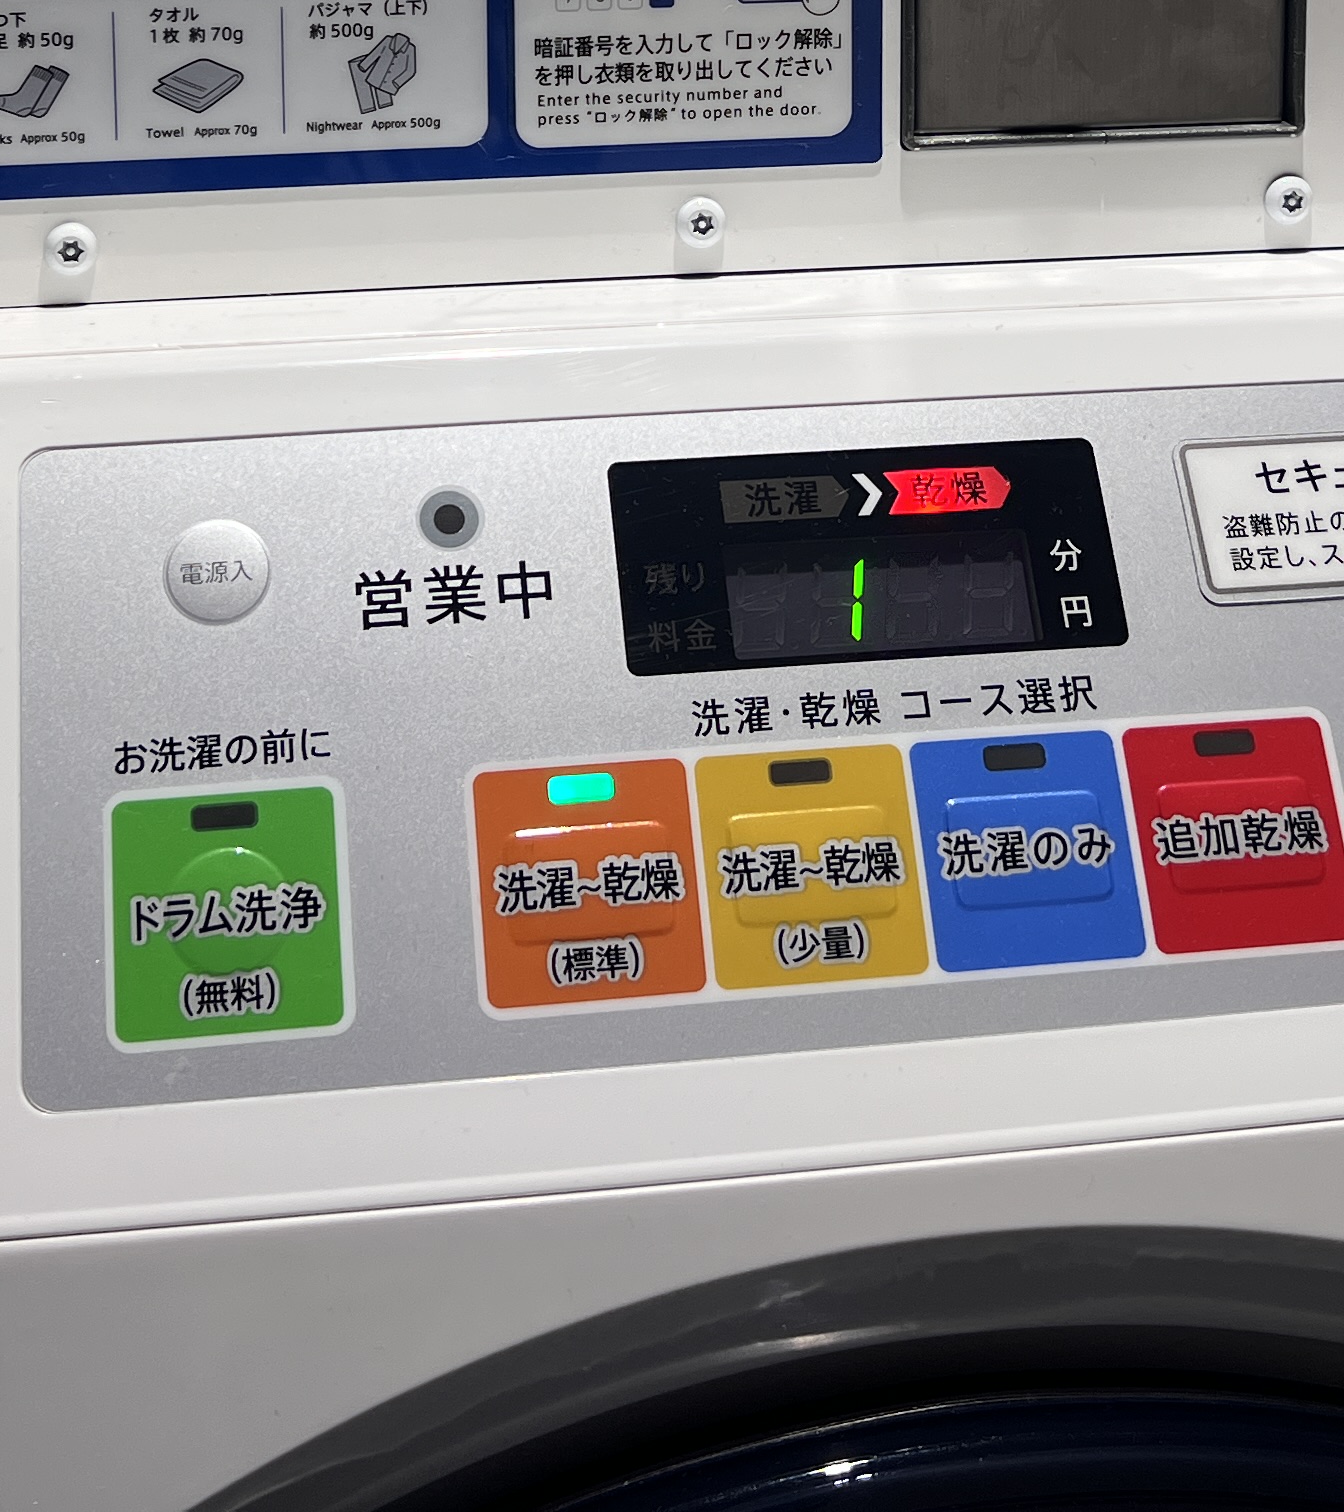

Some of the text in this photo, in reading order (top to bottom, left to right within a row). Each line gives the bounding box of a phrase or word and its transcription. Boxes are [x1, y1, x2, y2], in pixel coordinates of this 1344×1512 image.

[150, 7, 199, 22] タオル
[744, 471, 988, 517] 洗濯 乾燥
[180, 561, 253, 585] 電源入
[1050, 539, 1081, 571] 分
[355, 561, 552, 630] 営業中
[1061, 596, 1092, 628] 円
[901, 676, 1097, 719] コース選択
[115, 729, 330, 774] お洗濯の前に
[943, 828, 1111, 876] 洗濯のみ
[1156, 811, 1323, 860] 追加乾燥
[136, 887, 321, 941] ドラム洗浄
